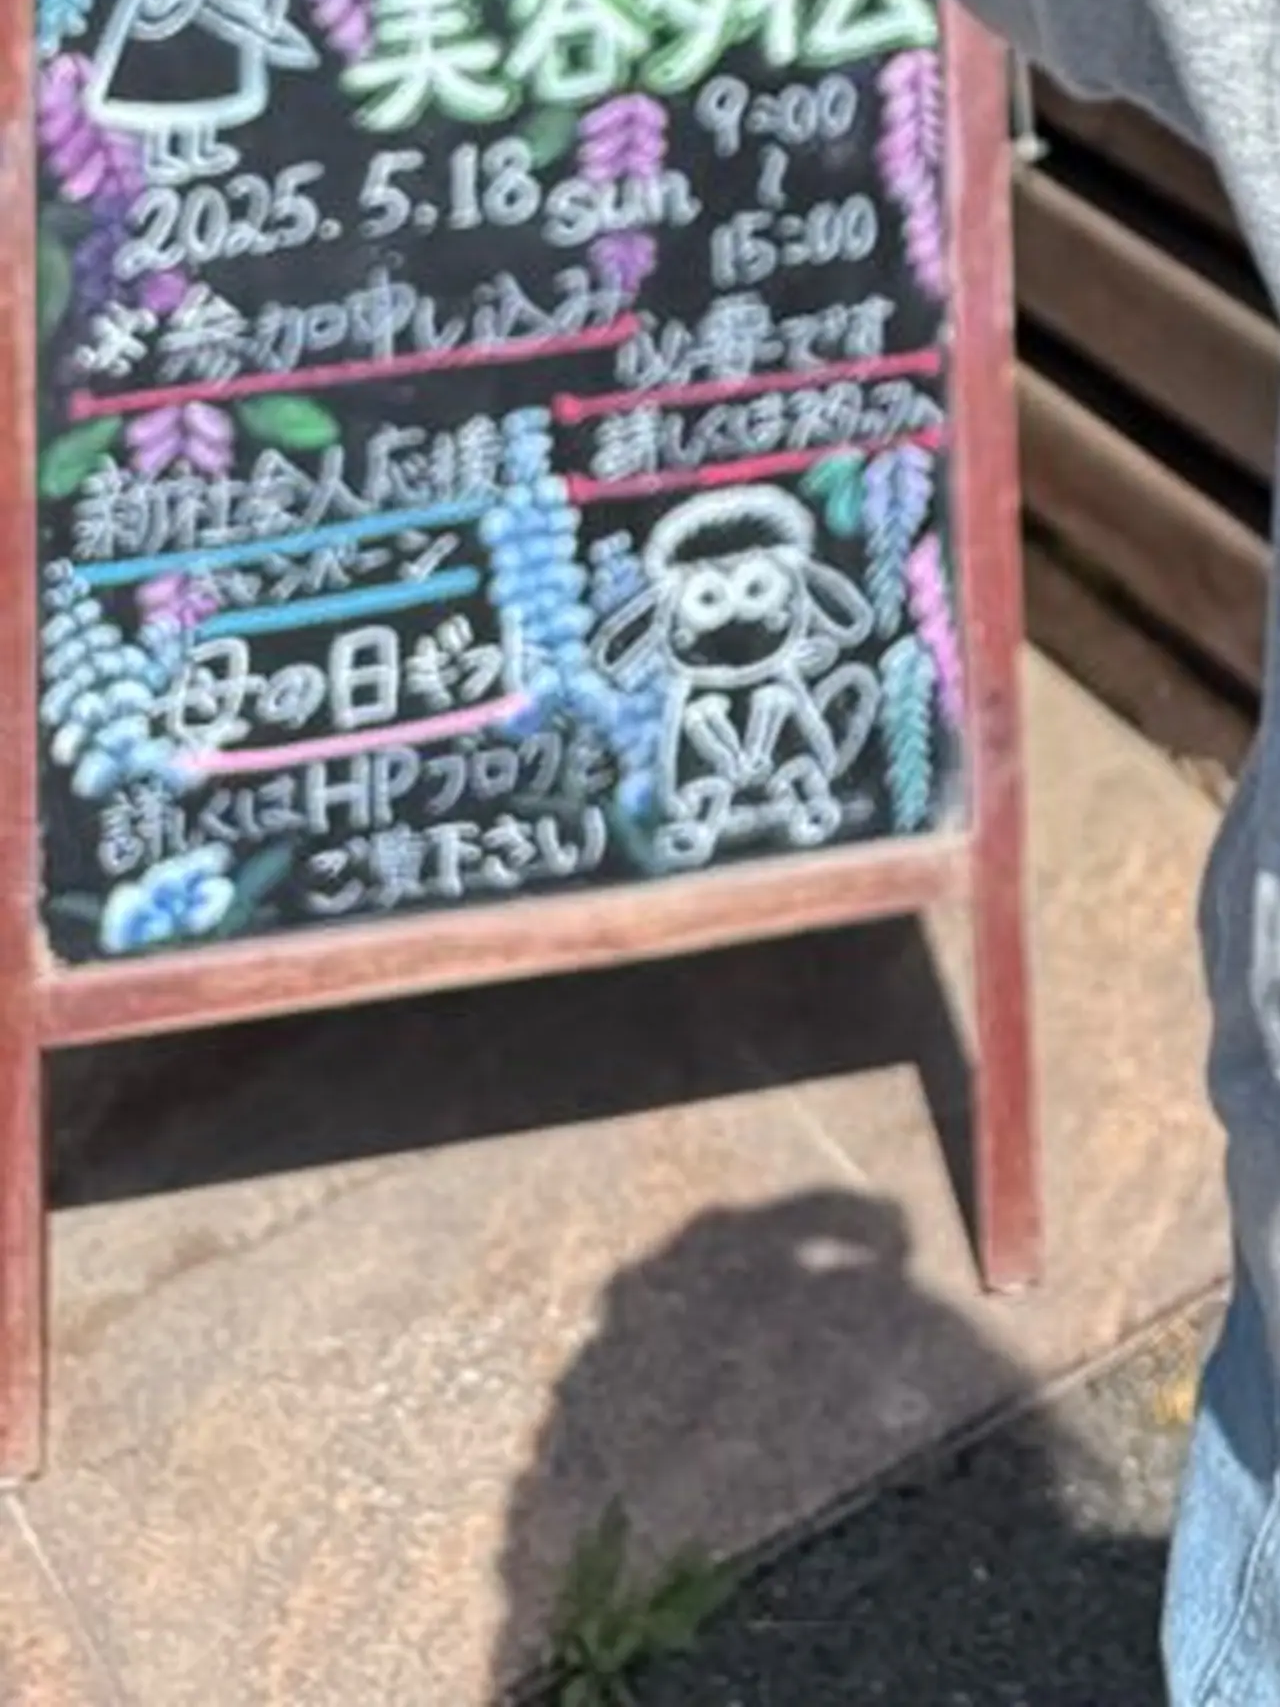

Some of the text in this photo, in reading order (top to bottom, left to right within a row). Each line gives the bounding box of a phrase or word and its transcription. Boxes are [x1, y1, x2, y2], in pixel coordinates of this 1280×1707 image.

[696, 75, 858, 157] 9:00
[710, 193, 878, 287] 15:00
[305, 805, 607, 915] ご覧下さい
